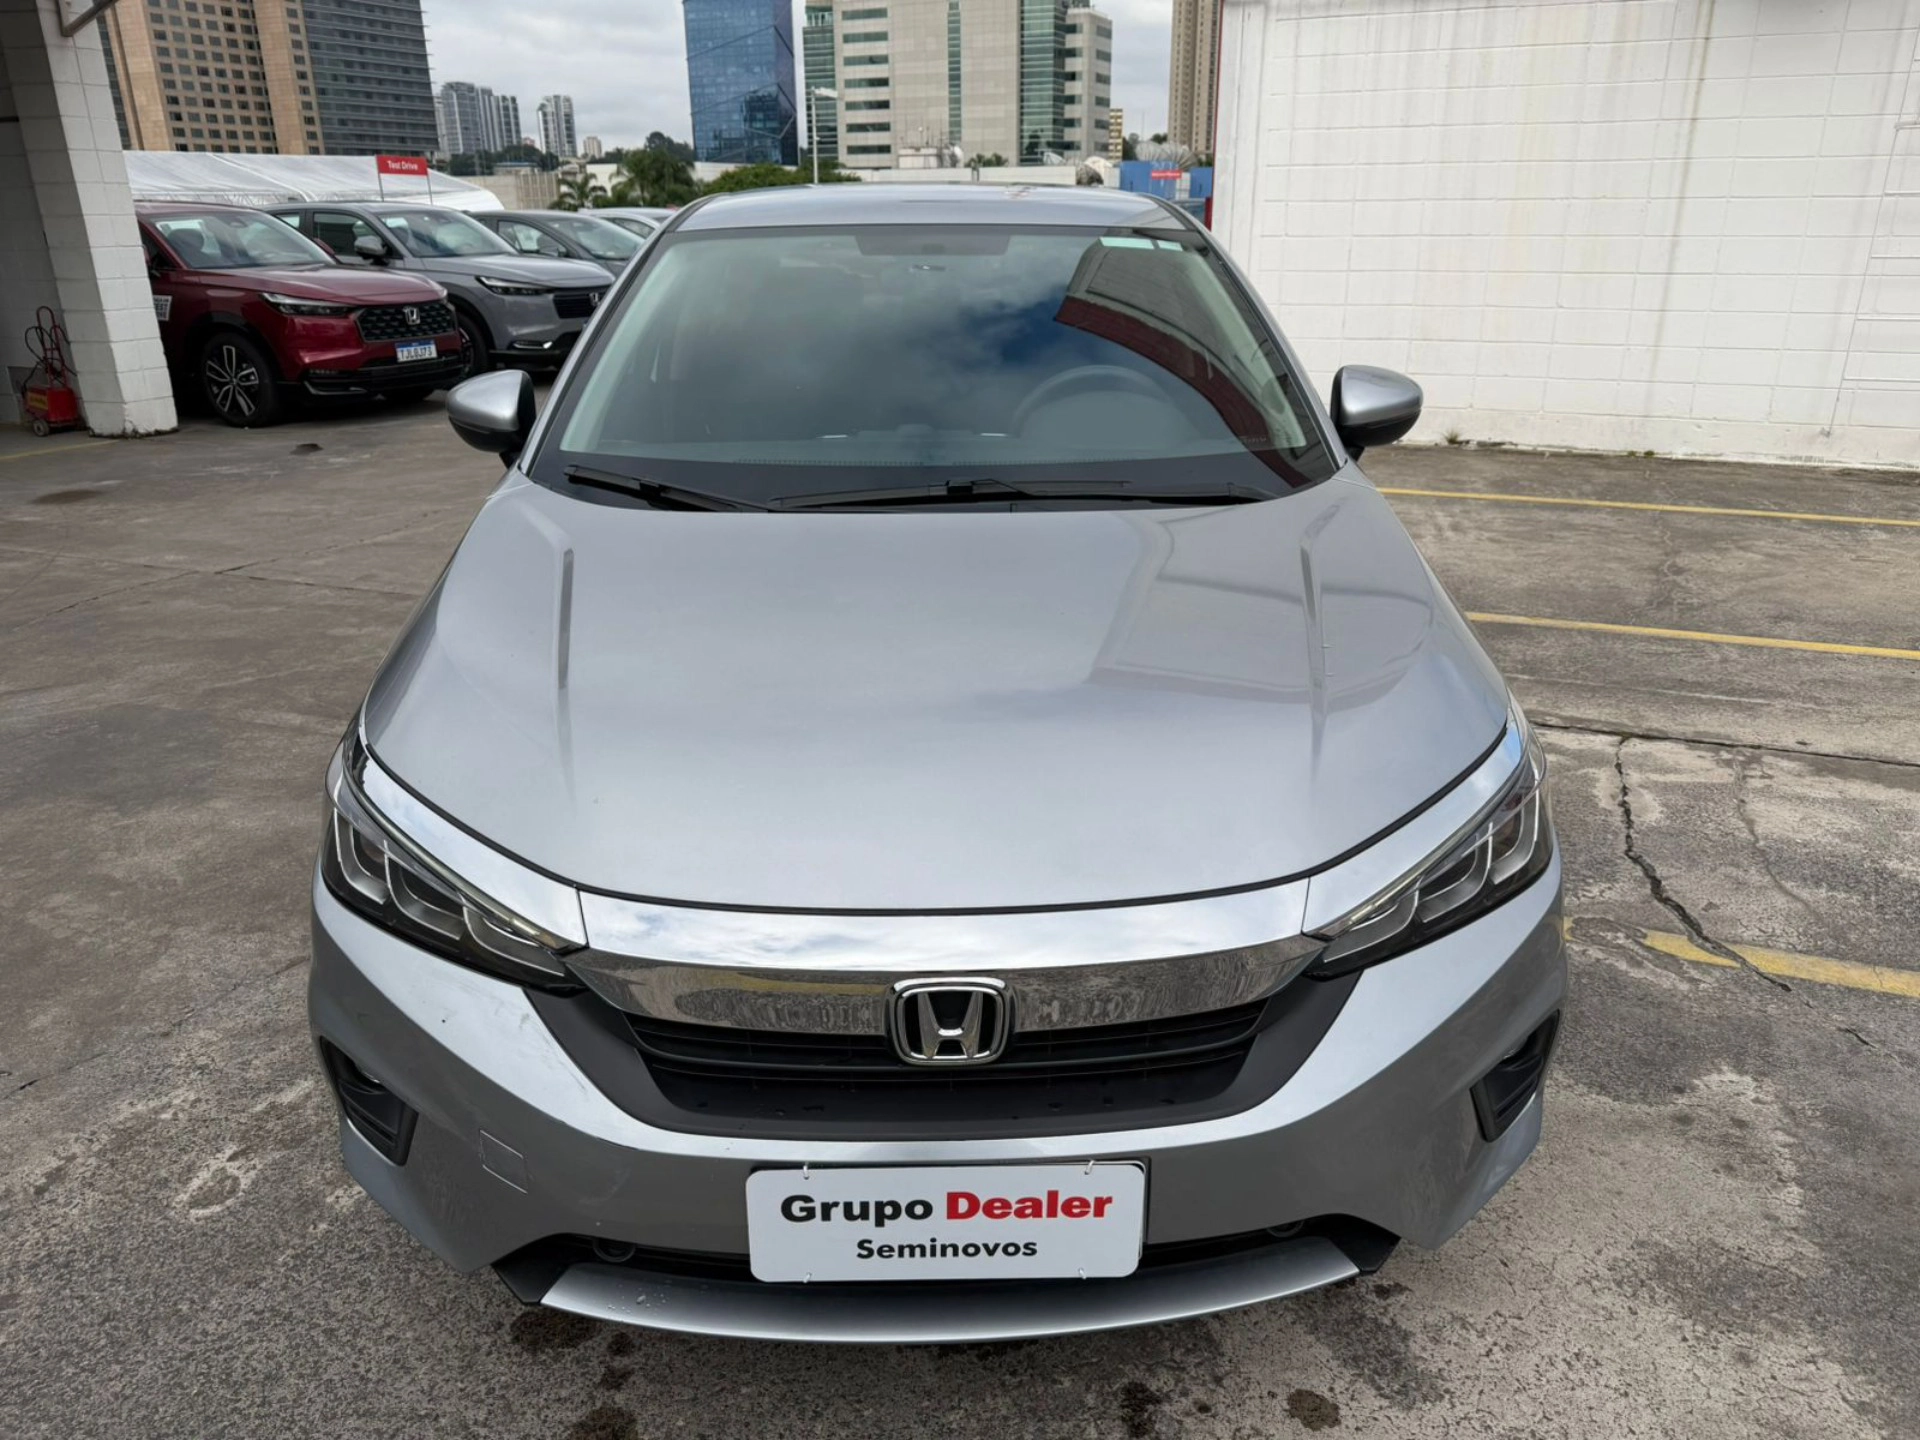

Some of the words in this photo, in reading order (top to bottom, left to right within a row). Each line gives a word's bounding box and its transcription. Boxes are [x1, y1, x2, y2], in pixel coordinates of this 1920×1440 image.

[780, 1194, 934, 1228] Grupo
[946, 1190, 1113, 1220] Dealer
[856, 1237, 1038, 1260] Seminovos
